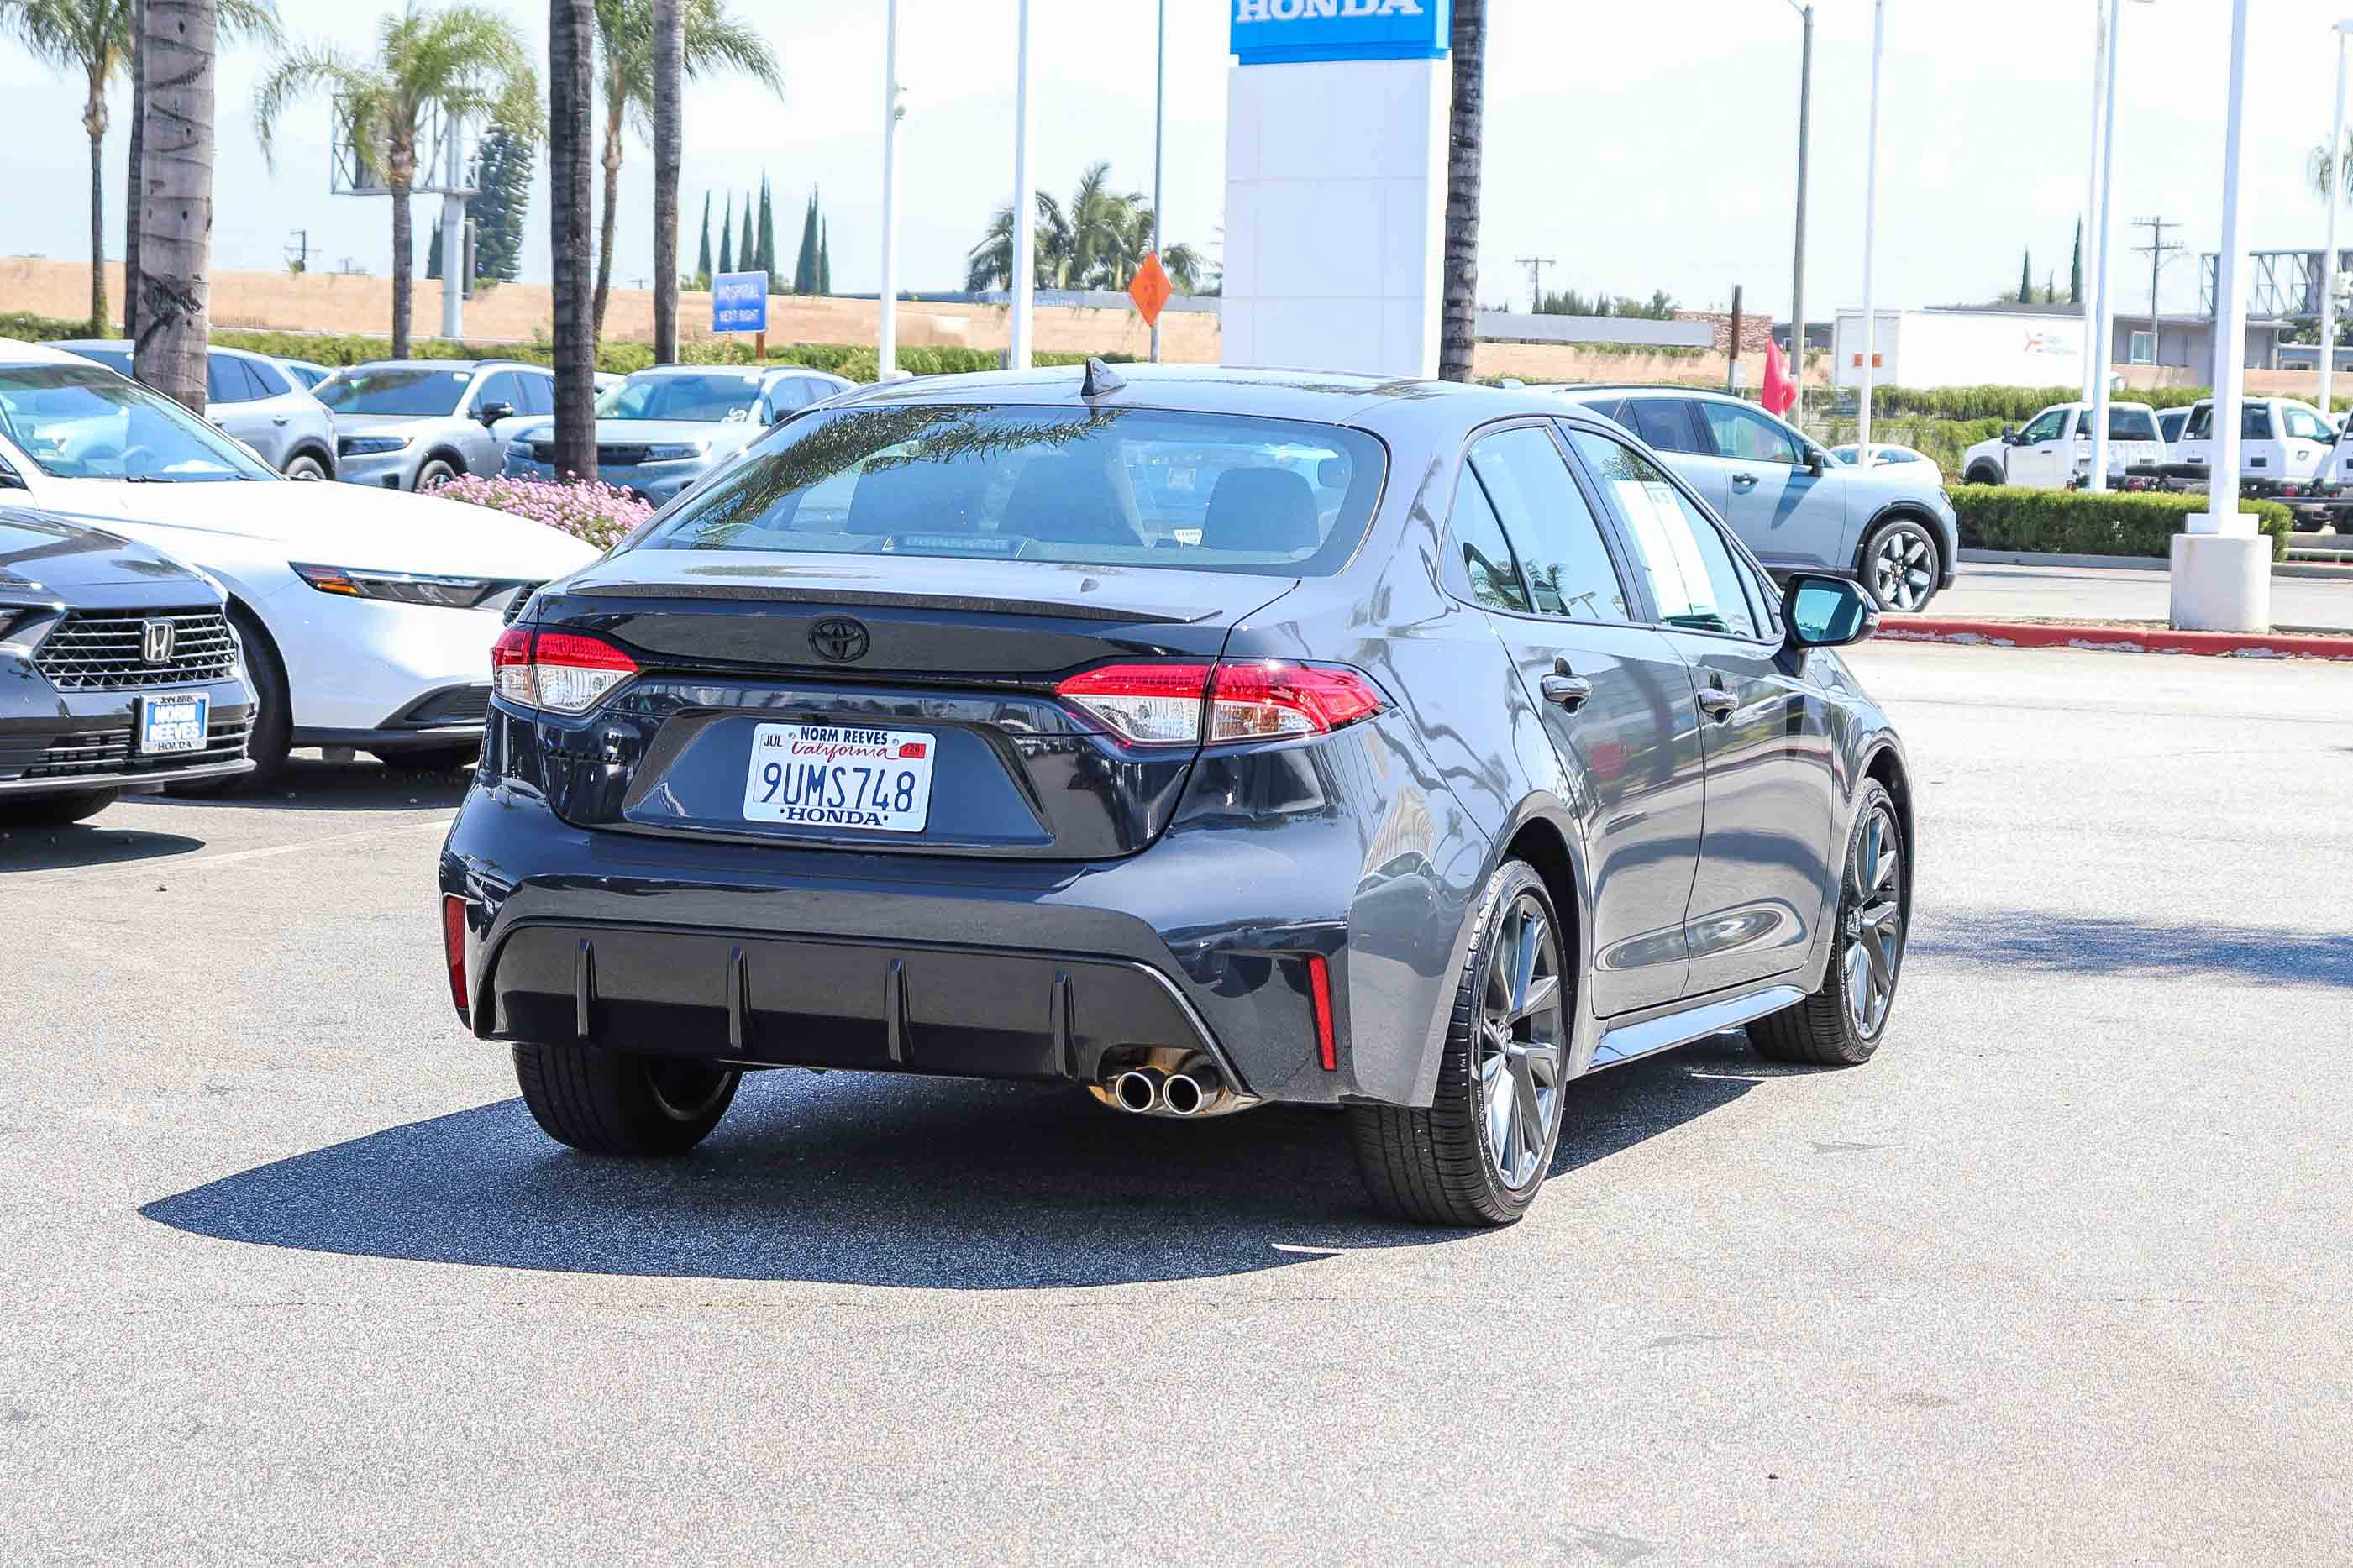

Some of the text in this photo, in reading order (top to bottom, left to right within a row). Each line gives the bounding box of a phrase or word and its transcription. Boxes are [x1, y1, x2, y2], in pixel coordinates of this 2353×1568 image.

[149, 721, 199, 740] REEVES
[763, 734, 783, 747] JUL
[801, 726, 888, 746] NORM REEVES
[791, 741, 899, 763] California
[760, 762, 917, 813] 9UMS748
[786, 806, 882, 826] HONDA
